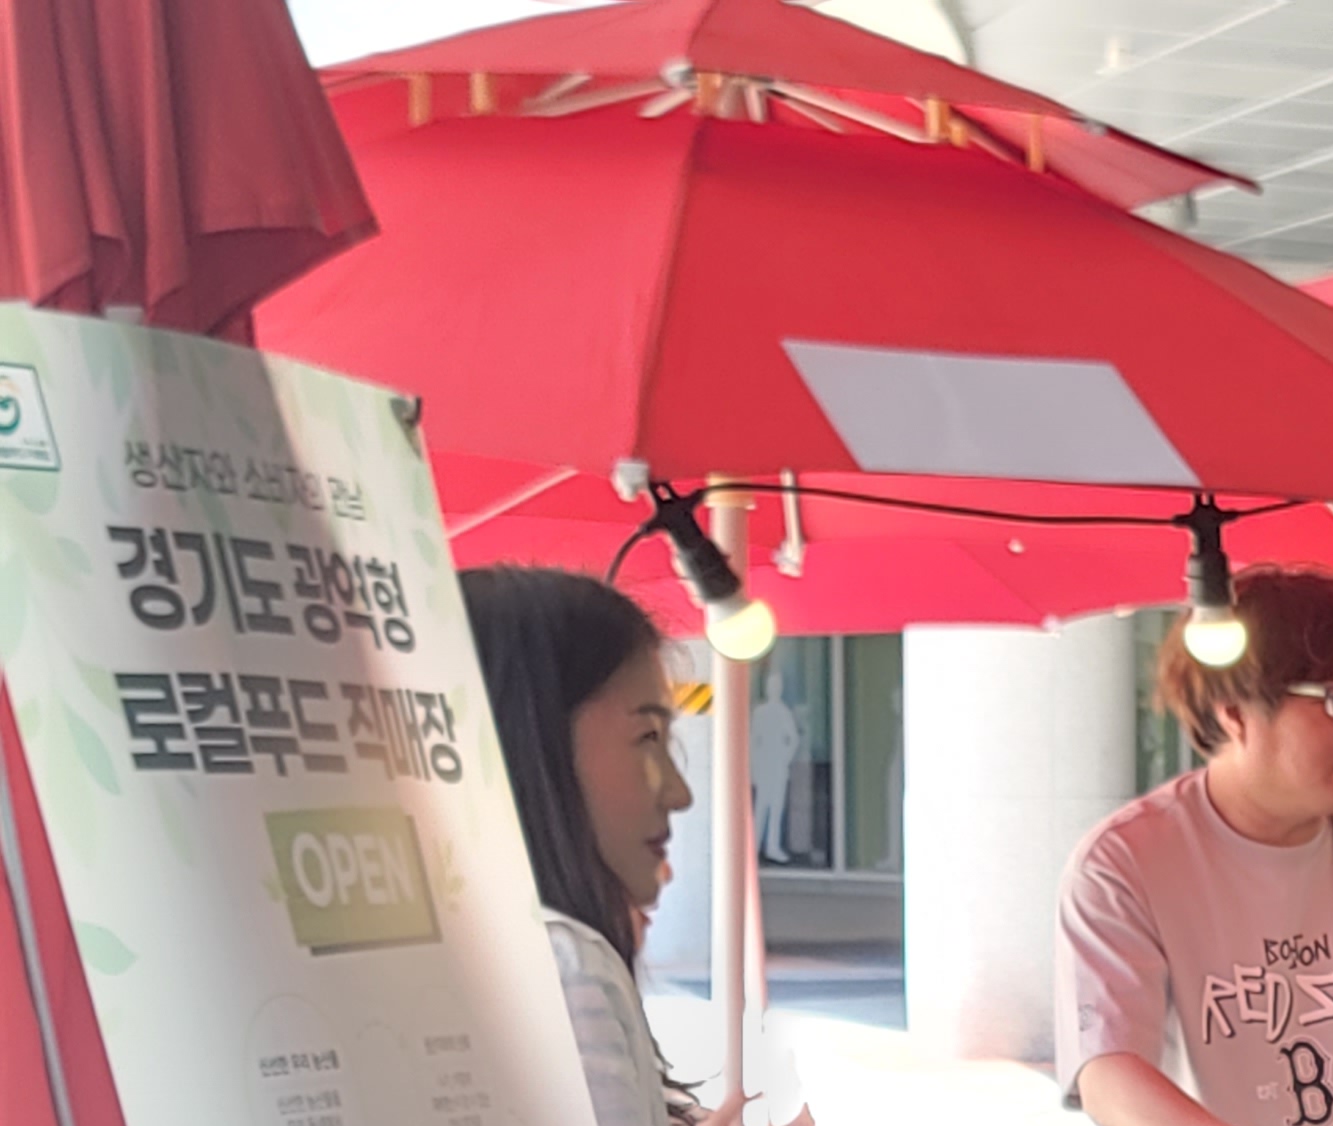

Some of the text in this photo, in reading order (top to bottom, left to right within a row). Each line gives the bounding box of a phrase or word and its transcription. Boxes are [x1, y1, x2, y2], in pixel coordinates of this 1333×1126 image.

[107, 525, 416, 655] 경기도 광역형
[115, 672, 463, 785] 로컬푸드 직매장
[291, 832, 410, 908] OPEN
